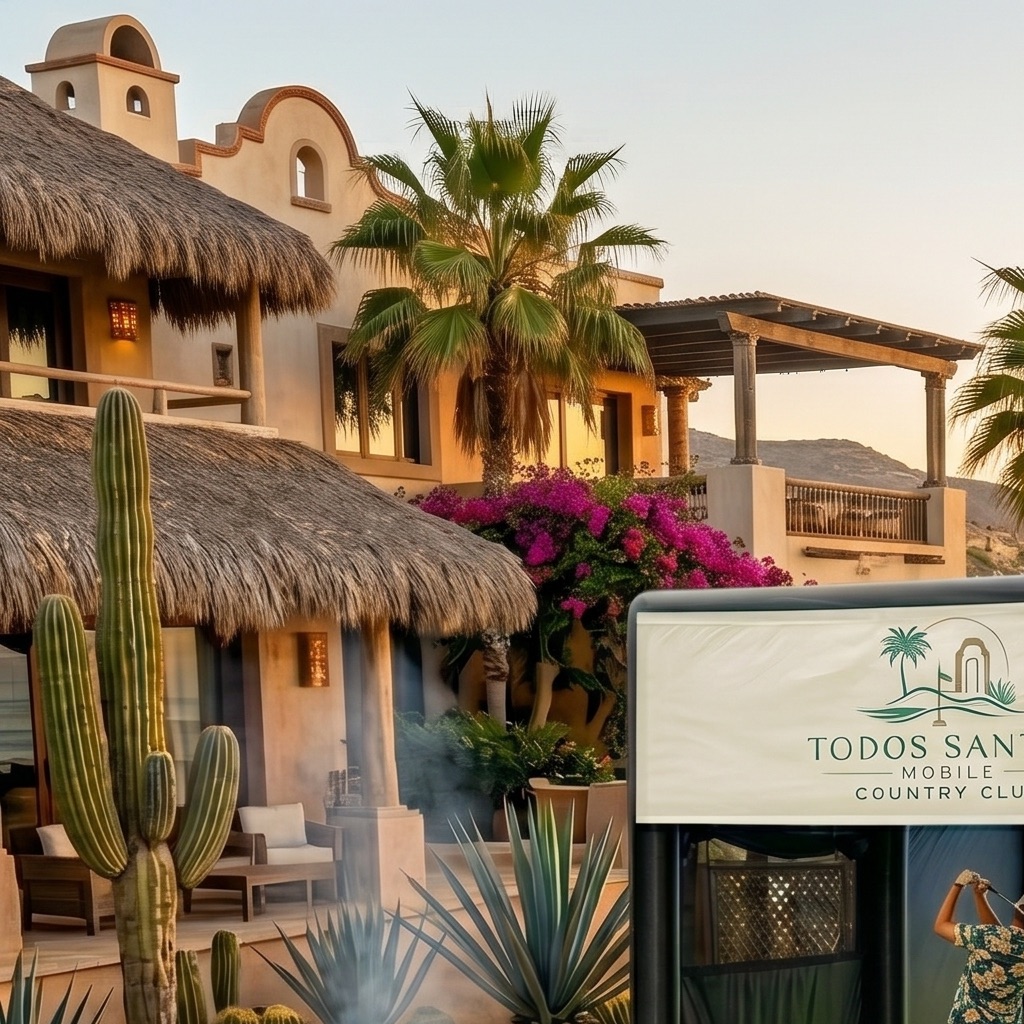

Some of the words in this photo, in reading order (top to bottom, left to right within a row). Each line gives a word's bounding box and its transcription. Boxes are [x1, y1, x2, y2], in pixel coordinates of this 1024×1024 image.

[807, 734, 927, 761] TODOS
[902, 765, 993, 780] MOBILE
[855, 786, 967, 800] COUNTRY
